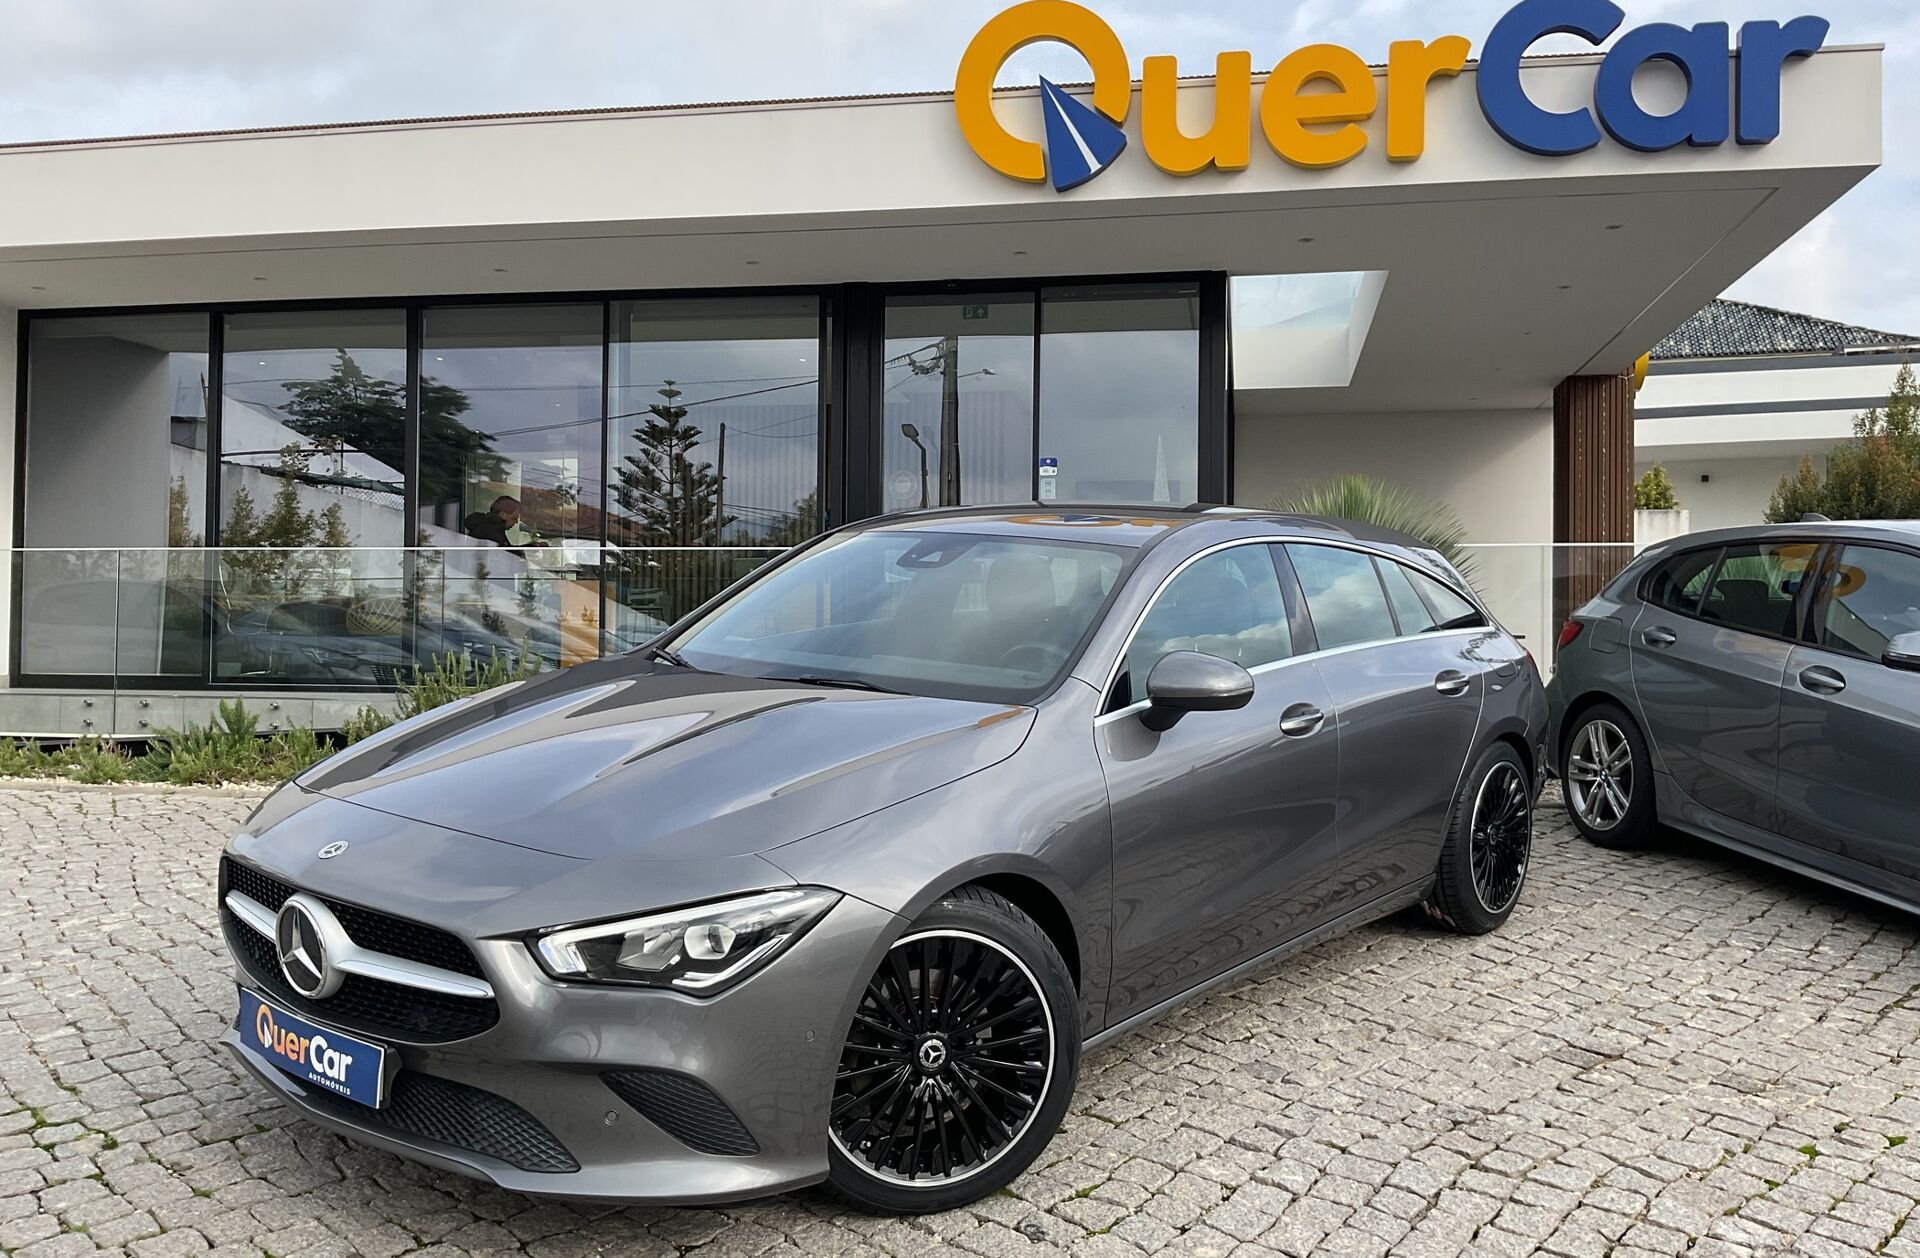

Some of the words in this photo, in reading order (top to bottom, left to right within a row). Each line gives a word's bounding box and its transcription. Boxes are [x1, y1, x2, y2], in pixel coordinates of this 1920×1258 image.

[955, 0, 1830, 191] QuerCar
[256, 1003, 353, 1082] QuerCar
[308, 1072, 351, 1095] AUTOMÓVEIS
